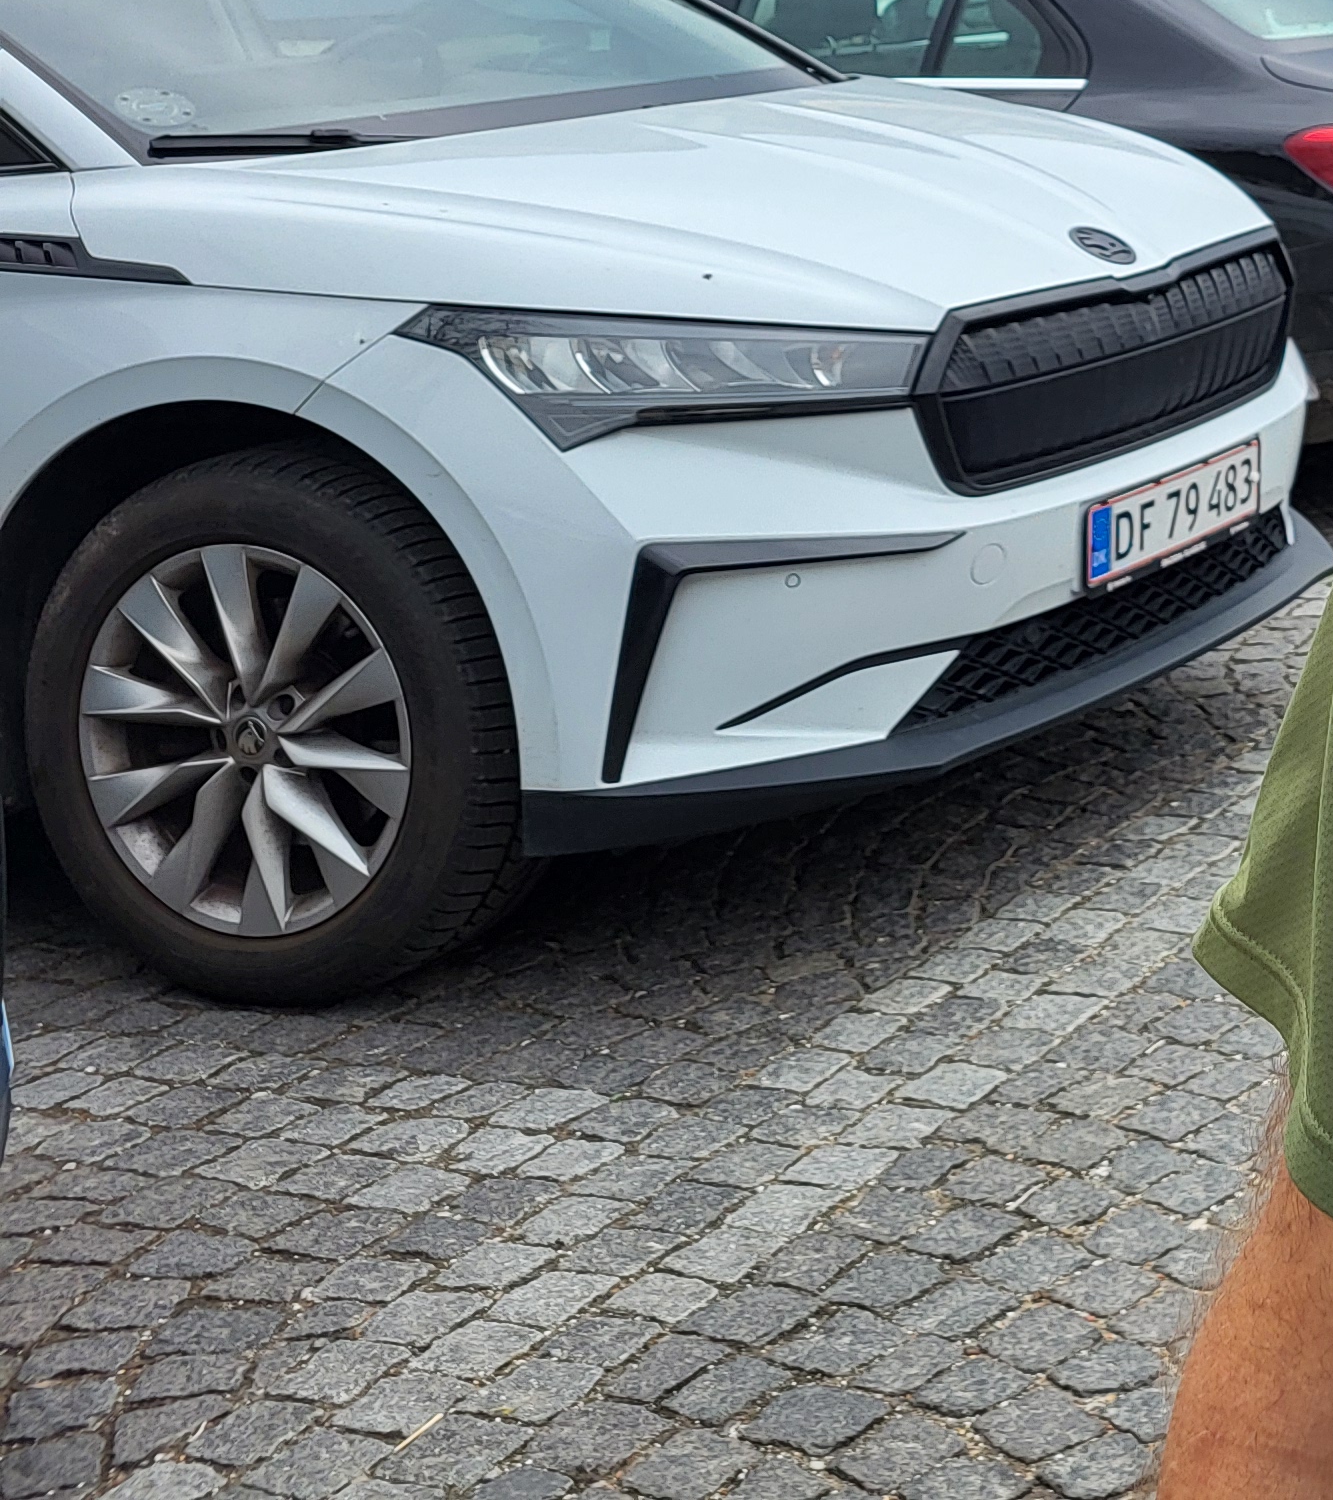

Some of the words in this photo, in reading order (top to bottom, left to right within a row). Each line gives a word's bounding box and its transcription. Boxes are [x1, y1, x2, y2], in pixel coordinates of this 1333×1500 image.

[1114, 499, 1156, 562] DF
[1165, 481, 1200, 540] 79
[1207, 457, 1253, 518] 483
